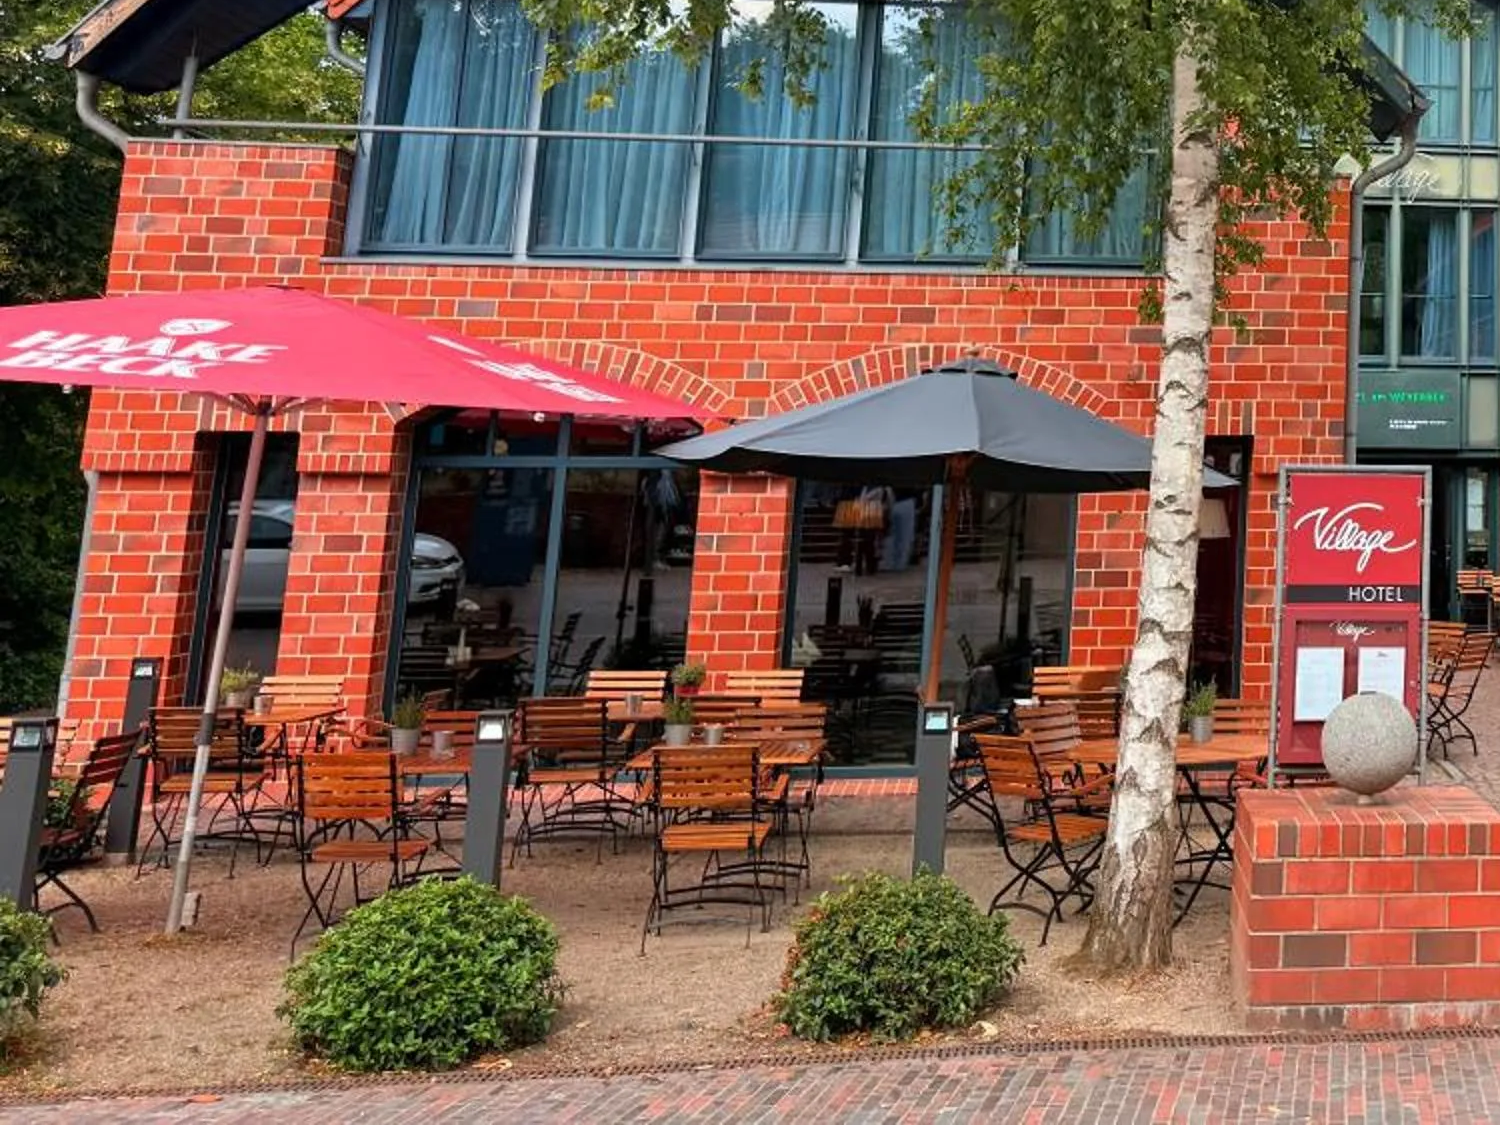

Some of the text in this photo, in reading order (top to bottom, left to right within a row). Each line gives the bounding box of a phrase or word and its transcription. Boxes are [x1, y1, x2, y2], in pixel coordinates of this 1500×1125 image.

[6, 330, 289, 364] HAAKE
[0, 350, 225, 379] BECK
[1293, 502, 1417, 574] Village
[1348, 586, 1404, 603] HOTEL
